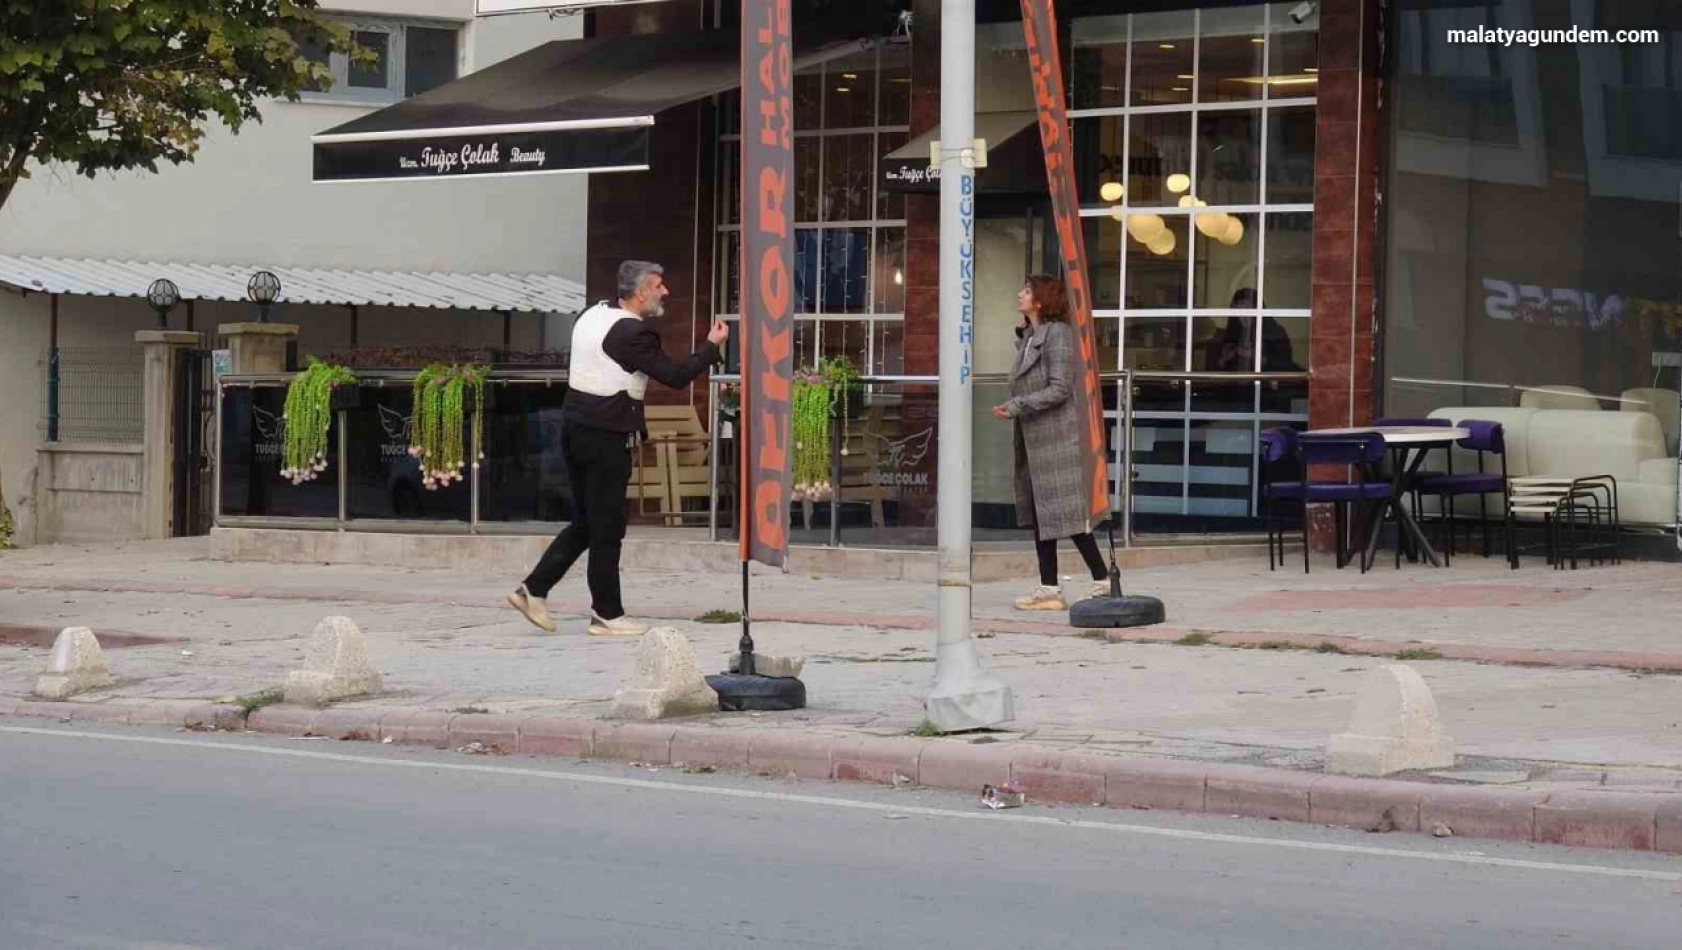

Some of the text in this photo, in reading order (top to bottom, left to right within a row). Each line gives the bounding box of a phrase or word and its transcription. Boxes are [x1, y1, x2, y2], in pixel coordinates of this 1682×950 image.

[421, 146, 458, 173] Tuğçe
[461, 142, 500, 170] Çolak
[510, 147, 546, 166] Beauty
[755, 162, 789, 550] DEKOR
